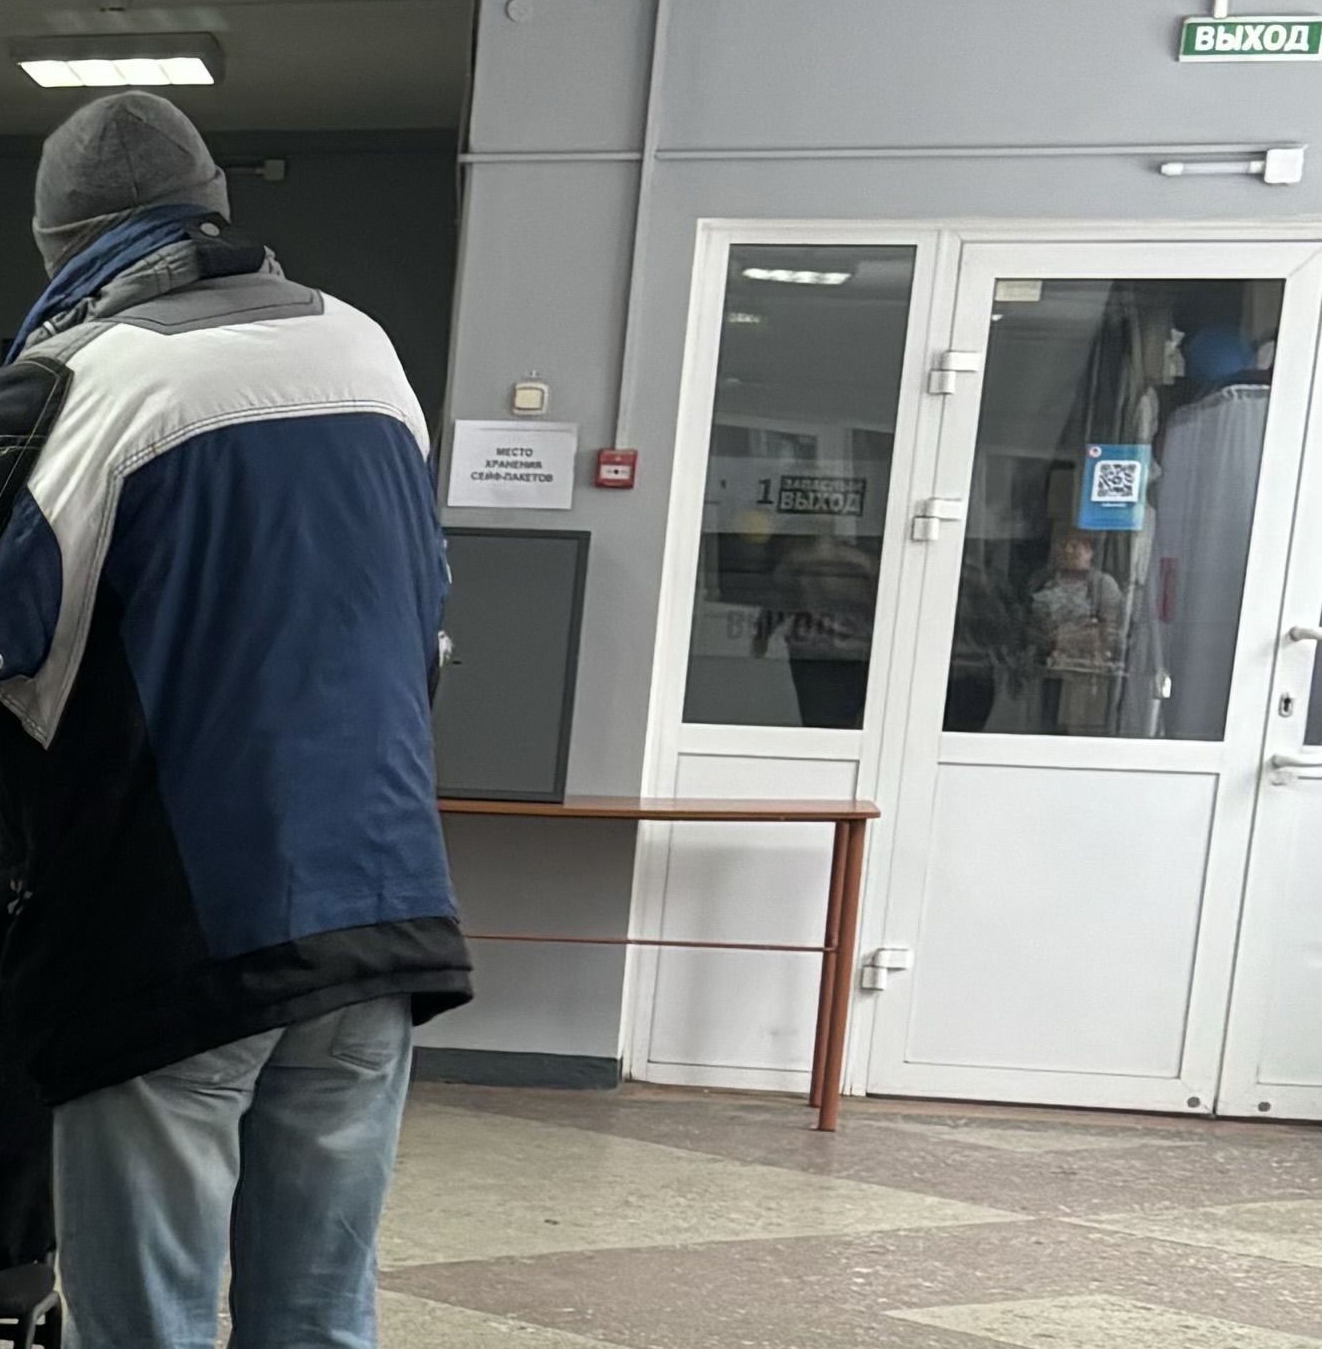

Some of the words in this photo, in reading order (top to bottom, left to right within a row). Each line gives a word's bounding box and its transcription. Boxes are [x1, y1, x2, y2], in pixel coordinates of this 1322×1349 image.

[1194, 24, 1310, 52] ВЫХОД
[496, 447, 533, 457] МЕСТО
[485, 459, 542, 469] ХРАНЕНИЯ
[470, 471, 553, 483] СЕЙФ-ПАКЕТОВ
[780, 490, 860, 514] ВЫХОД
